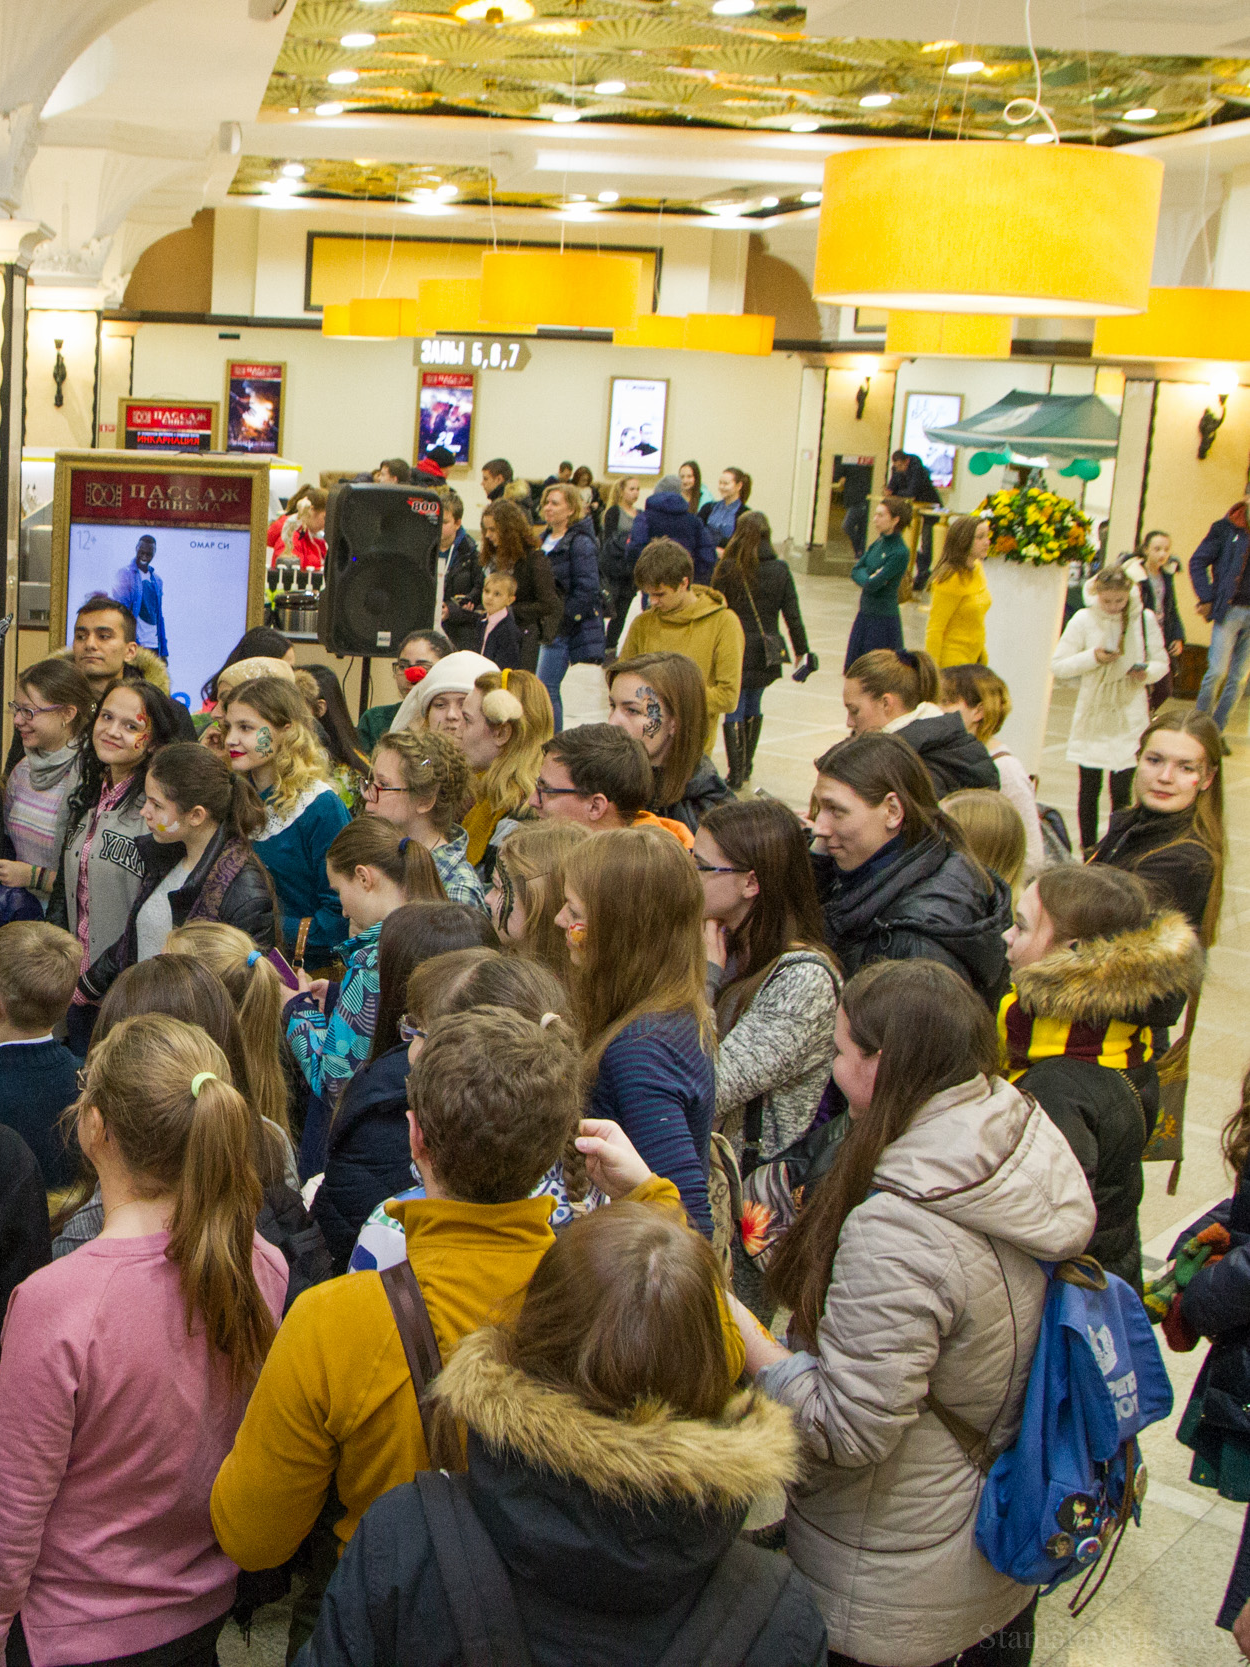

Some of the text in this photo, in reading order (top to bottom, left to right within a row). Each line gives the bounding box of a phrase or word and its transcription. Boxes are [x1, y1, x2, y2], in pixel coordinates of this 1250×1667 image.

[420, 339, 465, 365] ЗАЛЫ
[137, 435, 200, 446] ИНКАРНАЦИЯ
[129, 484, 240, 503] ПАССАЖ
[147, 500, 222, 512] СИНЕМА
[412, 501, 438, 513] 800
[189, 540, 230, 550] ОМАР СИ
